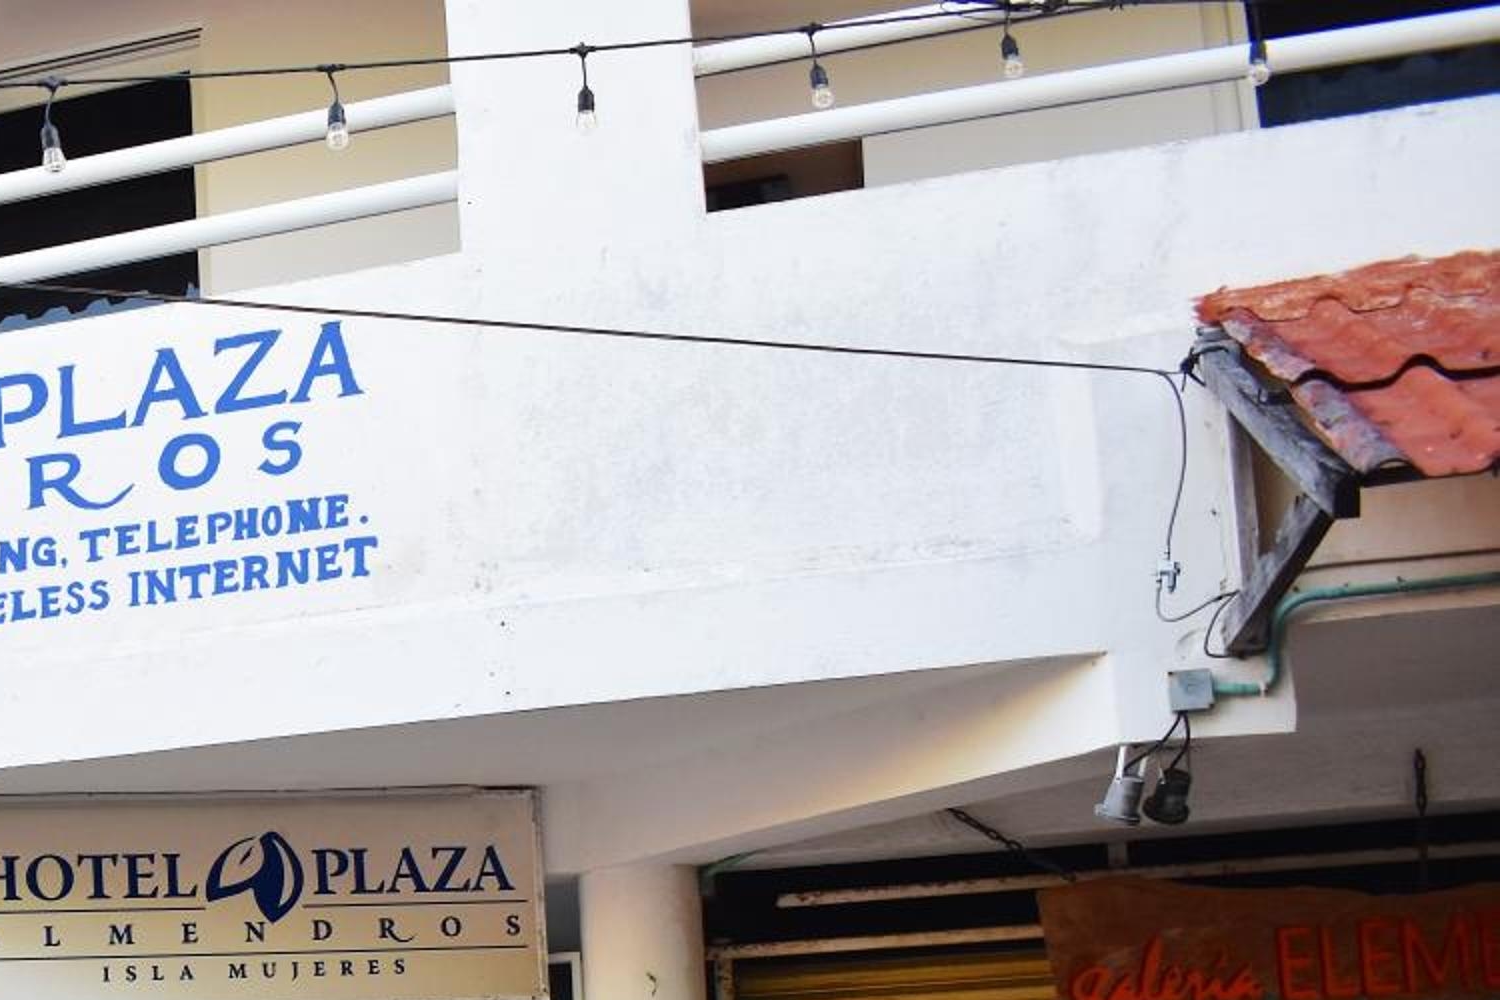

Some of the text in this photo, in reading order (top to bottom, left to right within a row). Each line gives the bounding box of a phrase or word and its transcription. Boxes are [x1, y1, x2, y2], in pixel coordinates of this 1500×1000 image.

[79, 494, 369, 564] TELEPHONE.
[128, 535, 379, 609] INTERNET
[311, 844, 517, 896] PLAZA
[101, 957, 407, 983] ISLA MUJERES
